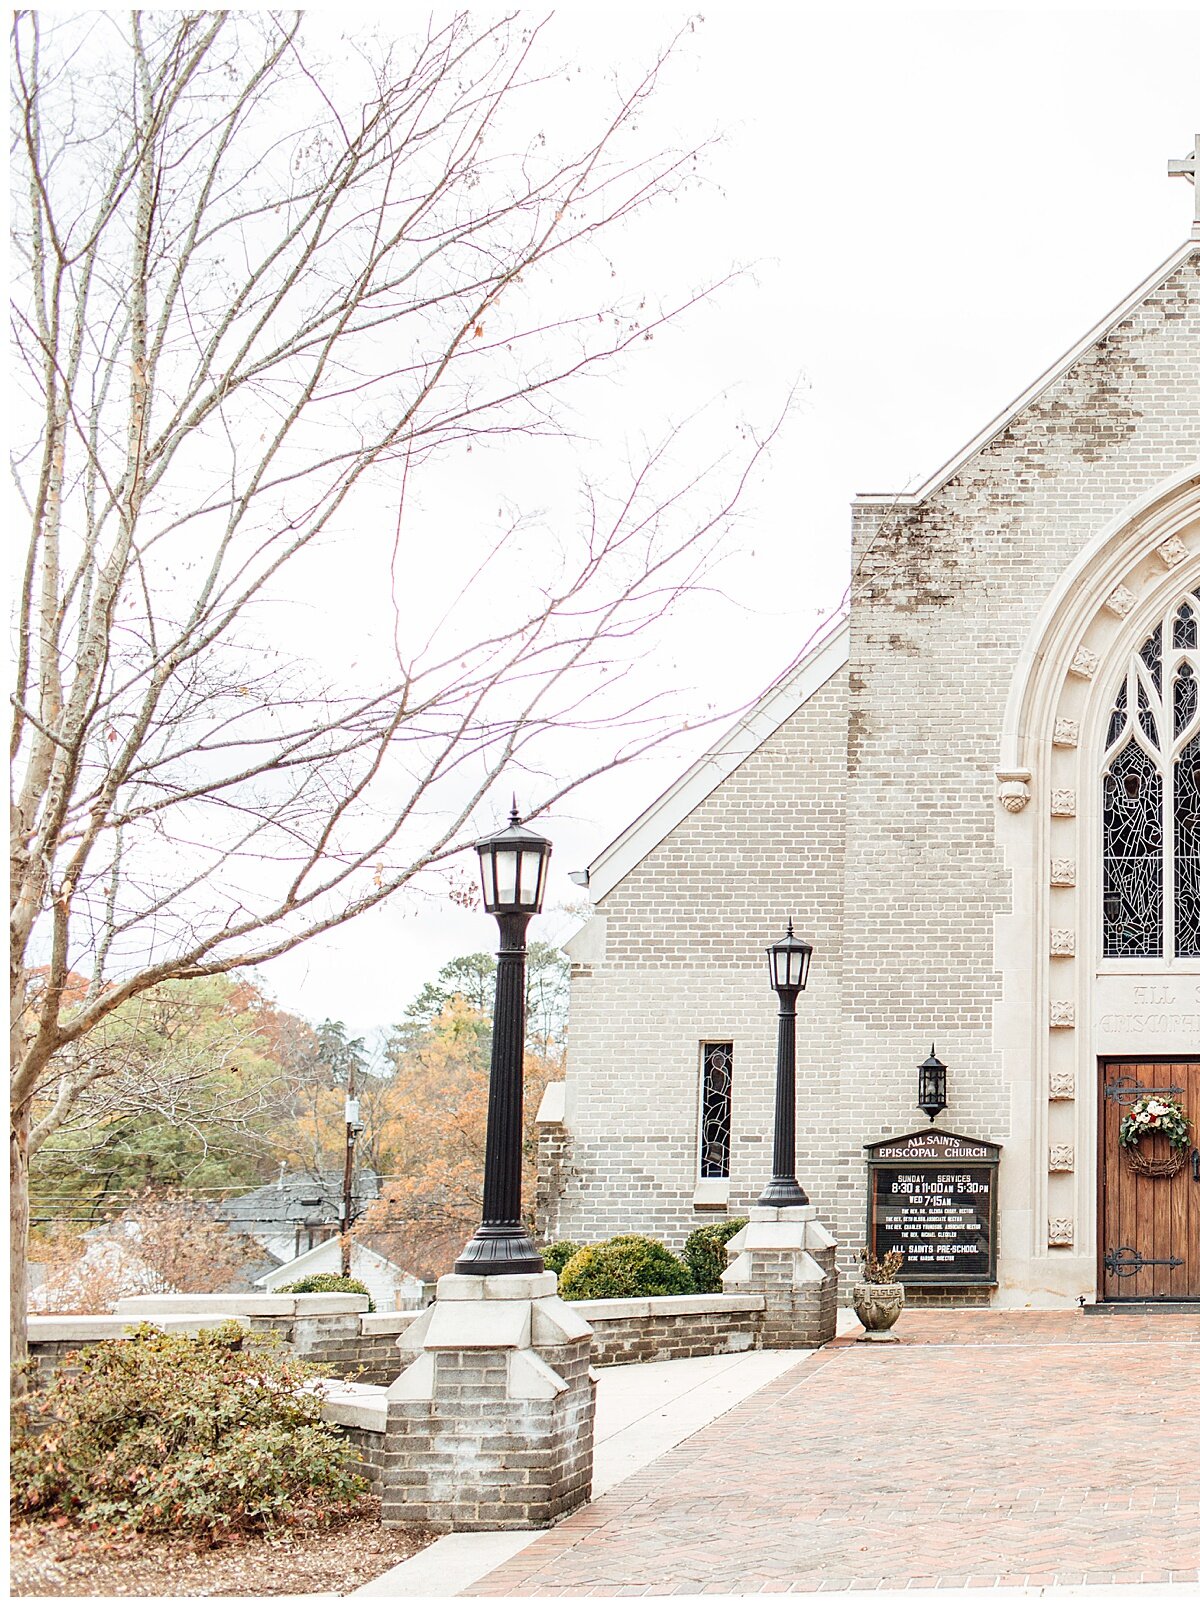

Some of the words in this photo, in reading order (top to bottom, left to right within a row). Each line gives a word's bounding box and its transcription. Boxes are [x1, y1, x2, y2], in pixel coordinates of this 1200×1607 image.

[1133, 985, 1177, 1005] ALL
[907, 1136, 925, 1148] ALL
[879, 1148, 938, 1157] EPISCOPAL
[944, 1148, 987, 1157] CHURCH
[892, 1183, 912, 1193] 8:30
[909, 1196, 923, 1204] WED
[892, 1245, 905, 1253] ALL
[908, 1245, 933, 1253] SAINTS
[937, 1245, 979, 1253] PRE-SCHOOL
